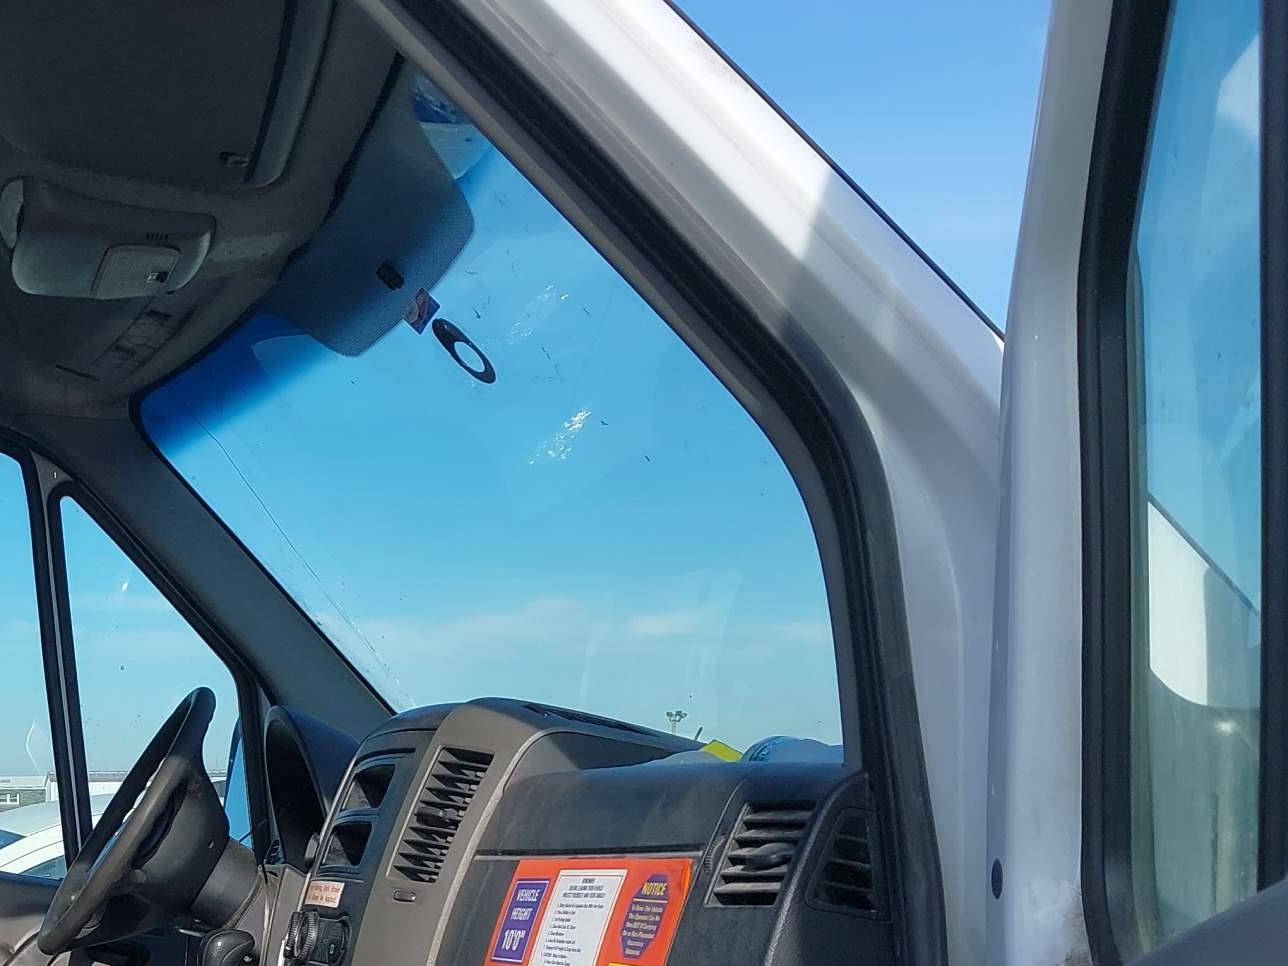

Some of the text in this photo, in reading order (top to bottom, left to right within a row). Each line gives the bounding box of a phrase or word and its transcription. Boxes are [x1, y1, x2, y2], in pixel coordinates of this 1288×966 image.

[516, 888, 541, 901] VEHICLE
[641, 882, 668, 896] NOTICE
[510, 907, 533, 920] HEIGHT
